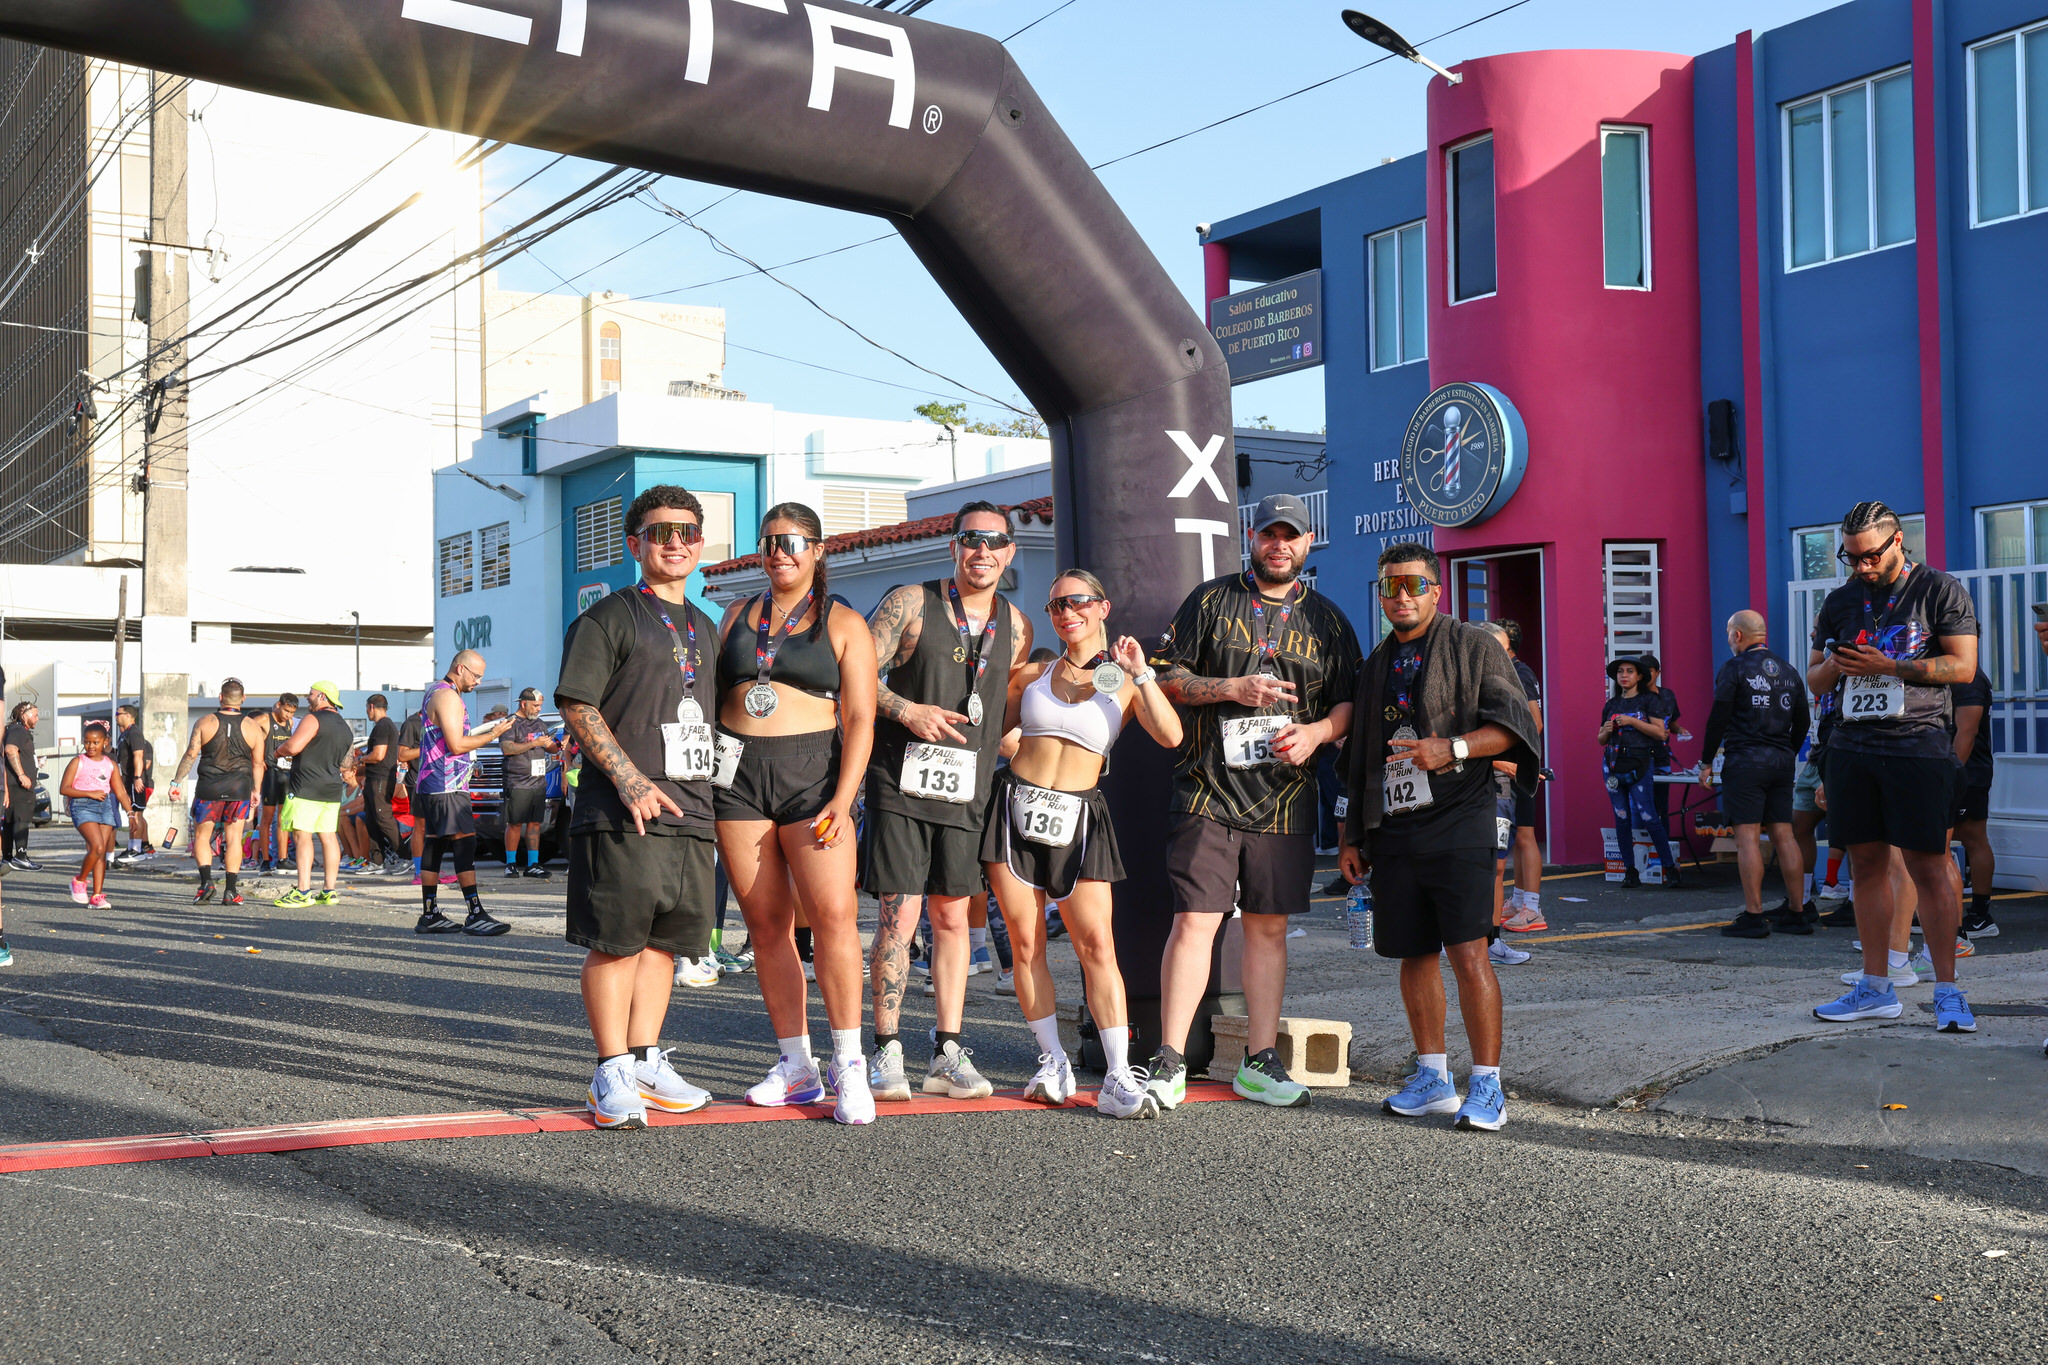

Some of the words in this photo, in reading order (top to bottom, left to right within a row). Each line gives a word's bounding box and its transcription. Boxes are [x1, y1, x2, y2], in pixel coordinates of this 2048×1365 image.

[1229, 300, 1252, 317] Salón
[1255, 289, 1298, 309] Educativo
[1215, 320, 1252, 339] COLEGIO
[1254, 316, 1266, 330] DE
[1267, 303, 1313, 326] BARBEROS
[1228, 341, 1240, 355] DE
[1241, 332, 1276, 351] PUERTO
[1277, 326, 1300, 342] RICO
[1405, 433, 1417, 469] COLEGIO
[1413, 420, 1421, 432] DE
[1418, 392, 1447, 421] BARBEROS
[1446, 390, 1452, 399] Y
[1451, 389, 1482, 406] ESTILISTAS
[1479, 404, 1488, 414] EN
[1486, 412, 1499, 453] BARBERÍA
[1470, 441, 1485, 451] 1989
[1374, 458, 1401, 482] HER
[1418, 499, 1459, 521] PUERTO
[1461, 493, 1486, 516] RICO
[1355, 507, 1431, 535] PROFESIO
[1860, 675, 1881, 683] FADE
[1852, 693, 1888, 713] 223
[689, 726, 706, 734] FADE
[1249, 718, 1272, 727] FADE
[699, 735, 710, 743] RUN
[682, 748, 710, 771] 134
[932, 748, 958, 759] FADE
[943, 758, 964, 767] RUN
[1388, 761, 1405, 772] FADE
[1396, 768, 1413, 778] RUN
[919, 768, 960, 793] 133
[1037, 791, 1063, 802] FADE
[1385, 781, 1417, 807] 142
[1047, 802, 1068, 812] RUN
[1024, 810, 1063, 837] 136
